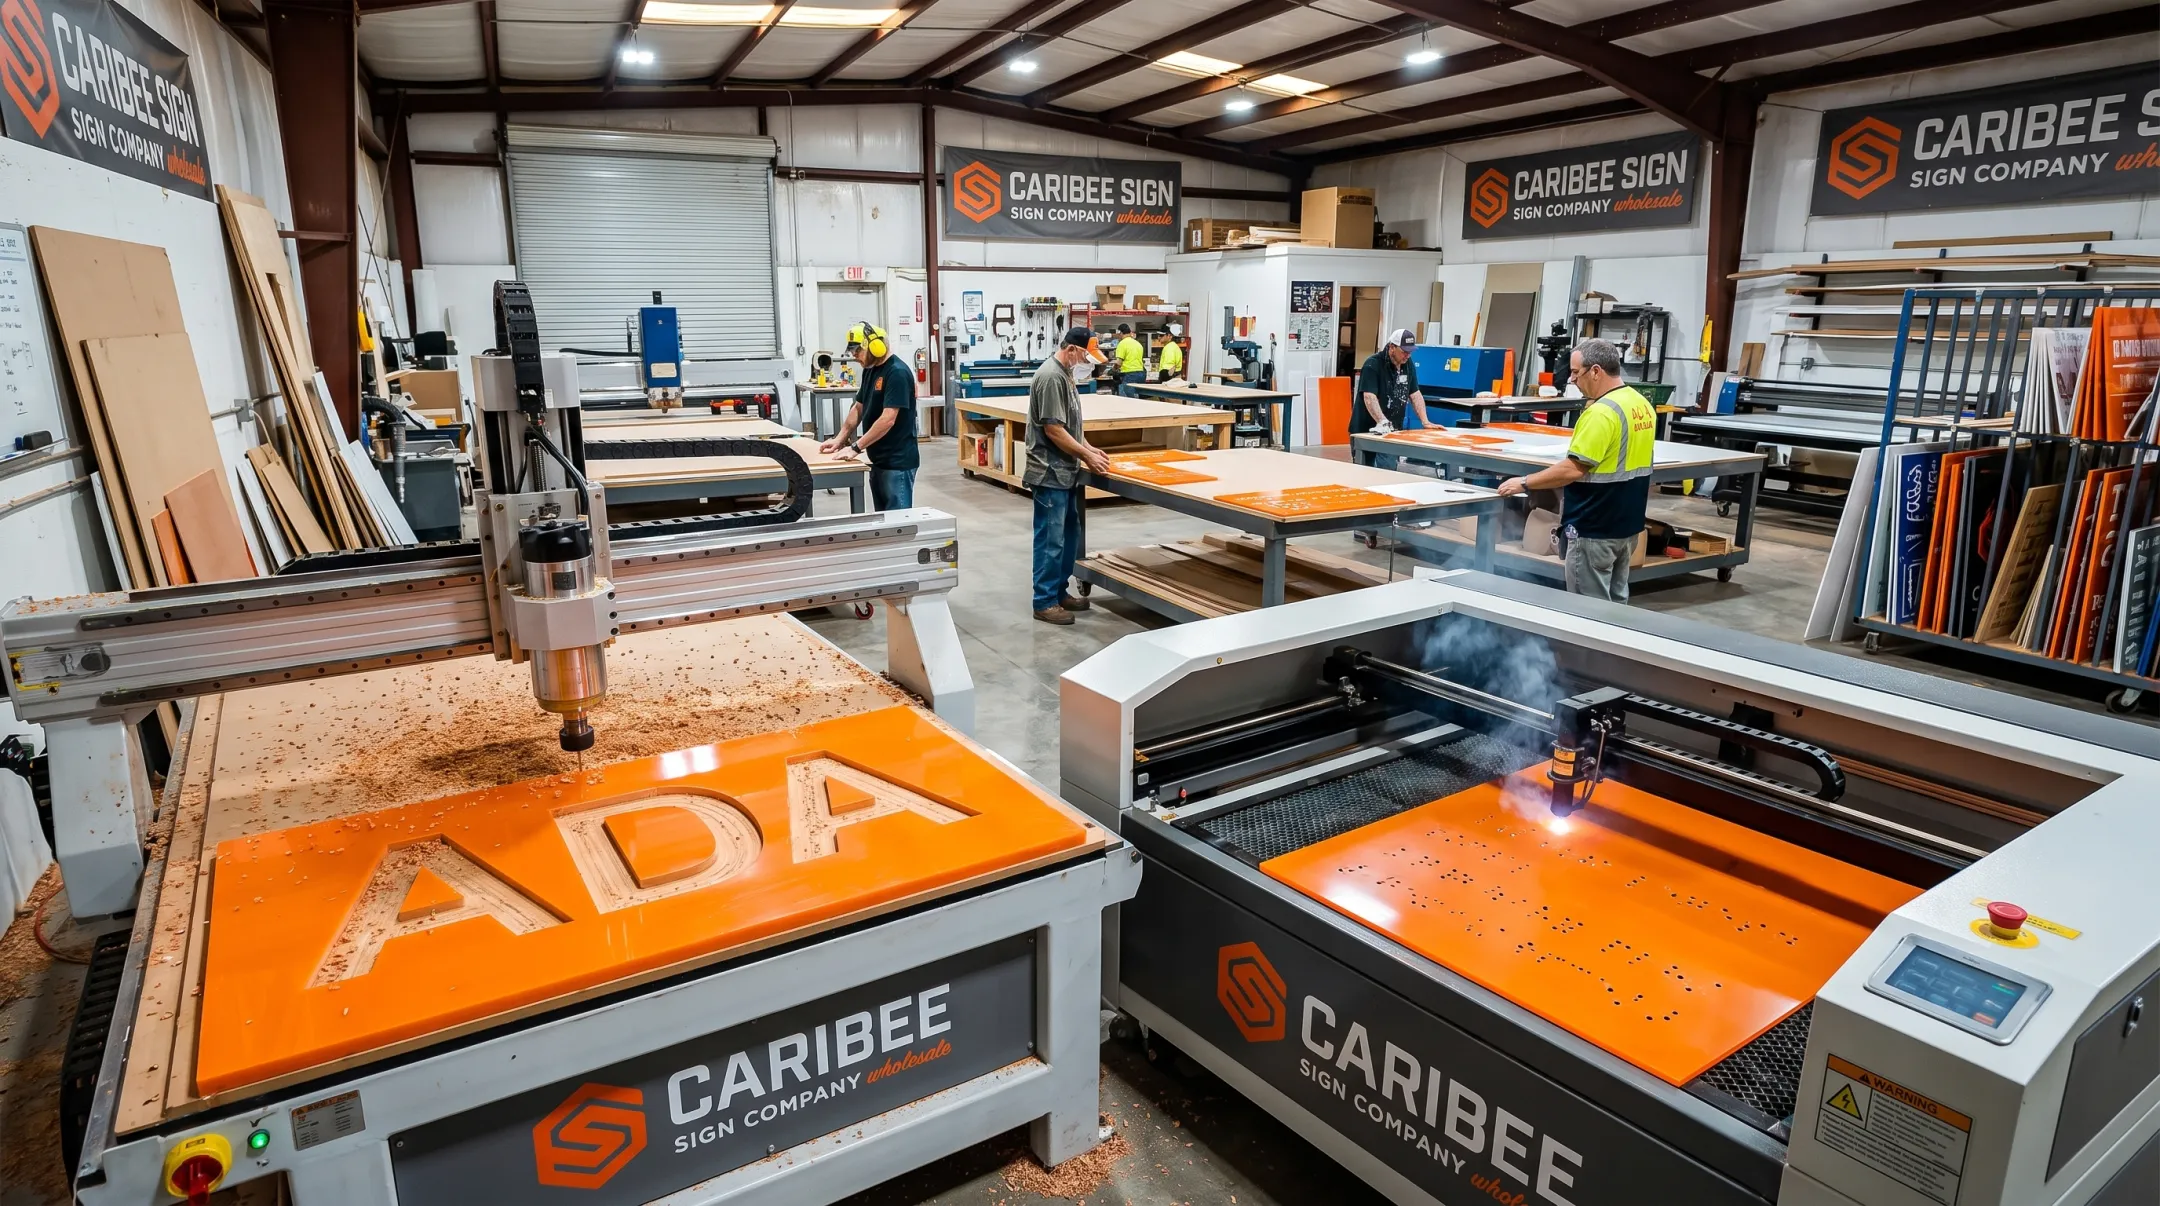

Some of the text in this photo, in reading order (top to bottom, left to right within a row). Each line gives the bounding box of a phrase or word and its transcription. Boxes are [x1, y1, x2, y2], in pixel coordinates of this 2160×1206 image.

[52, 12, 200, 148] CARIBEE SIGN
[70, 107, 206, 187] SIGN COMPANY wholesale
[1913, 93, 2127, 161] CARIBEE
[1009, 171, 1174, 207] CARIBEE SIGN
[1514, 149, 1688, 201] CARIBEE SIGN
[1909, 166, 1966, 188] SIGN
[1974, 152, 2109, 183] COMPANY
[1010, 206, 1173, 225] SIGN COMPANY wholesale
[1513, 188, 1684, 220] SIGN COMPANY wholesale
[847, 266, 864, 280] EXIT
[667, 983, 952, 1126] CARIBEE
[674, 1039, 953, 1155] SIGN COMPANY wholesale
[1300, 1057, 1346, 1101] SIGN
[1354, 1093, 1466, 1175] COMPANY
[1301, 994, 1584, 1206] CARIBEE
[1873, 1077, 1939, 1115] WARNING
